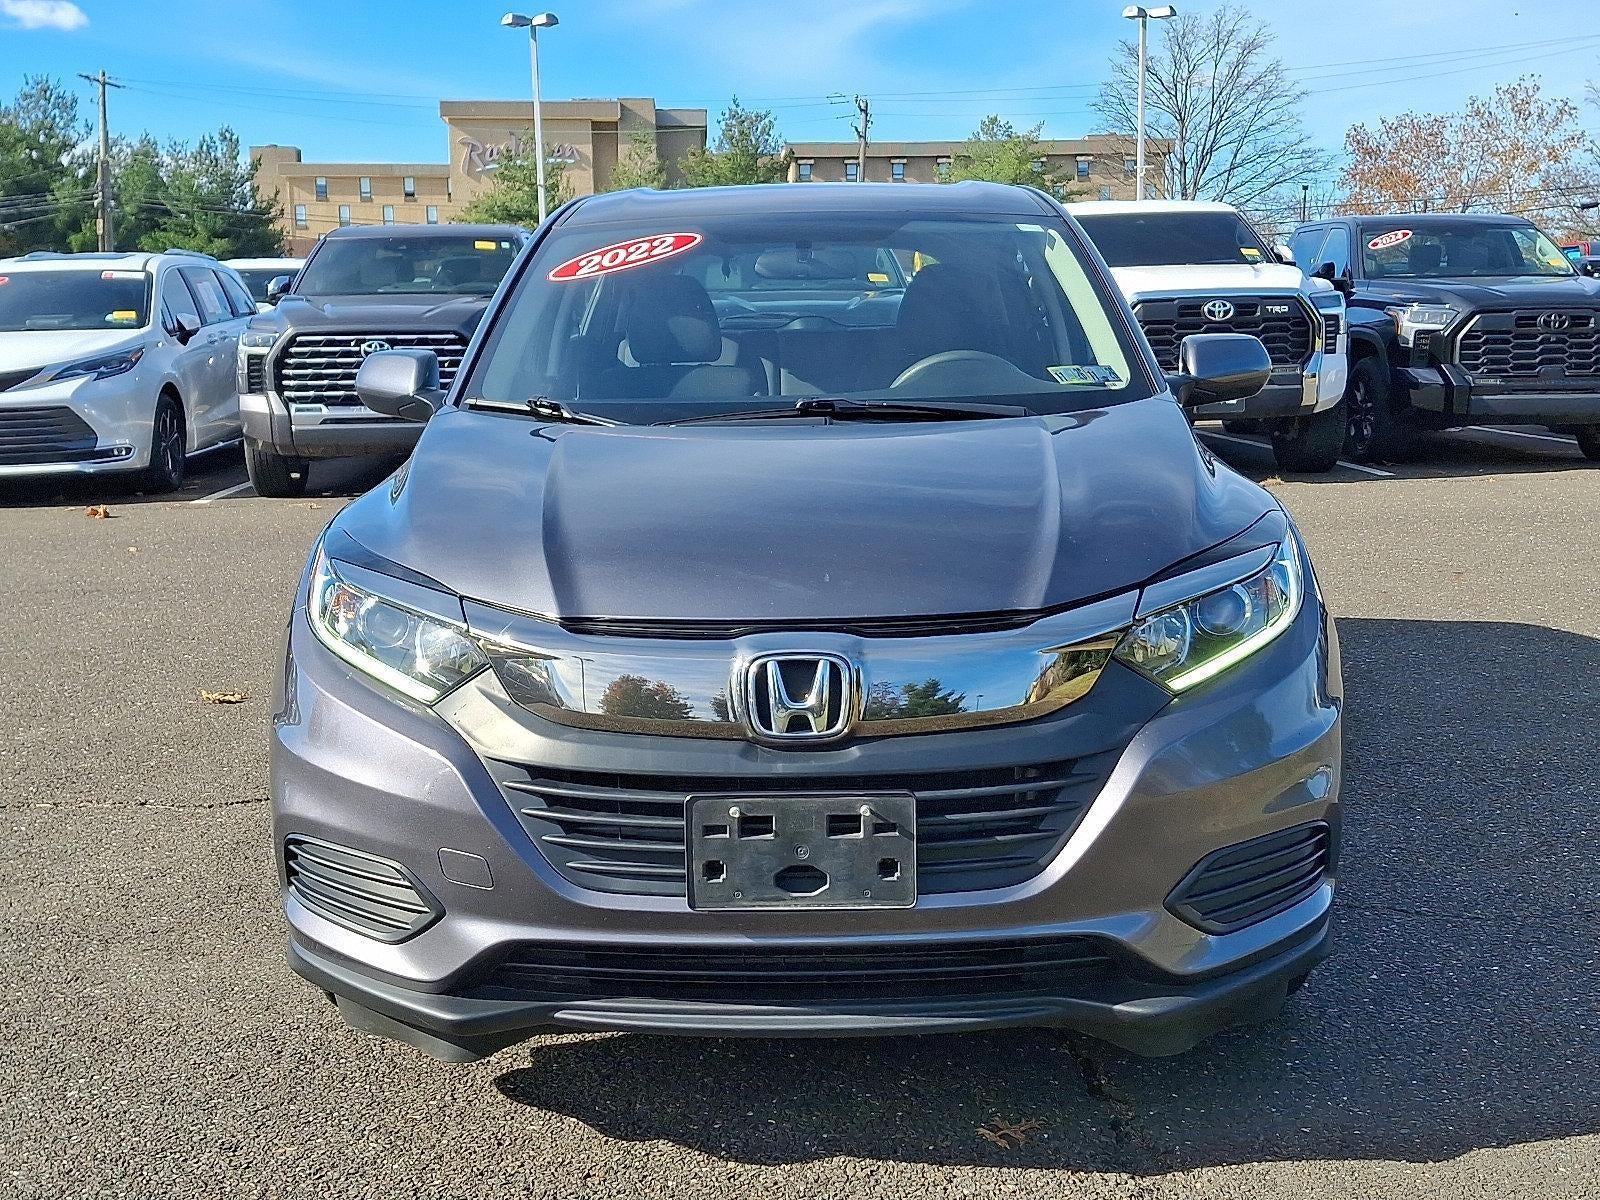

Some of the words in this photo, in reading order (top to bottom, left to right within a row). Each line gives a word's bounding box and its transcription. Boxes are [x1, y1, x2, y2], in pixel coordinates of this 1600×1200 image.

[457, 131, 581, 176] Radion
[575, 236, 676, 276] 2022
[1265, 305, 1289, 314] TRD
